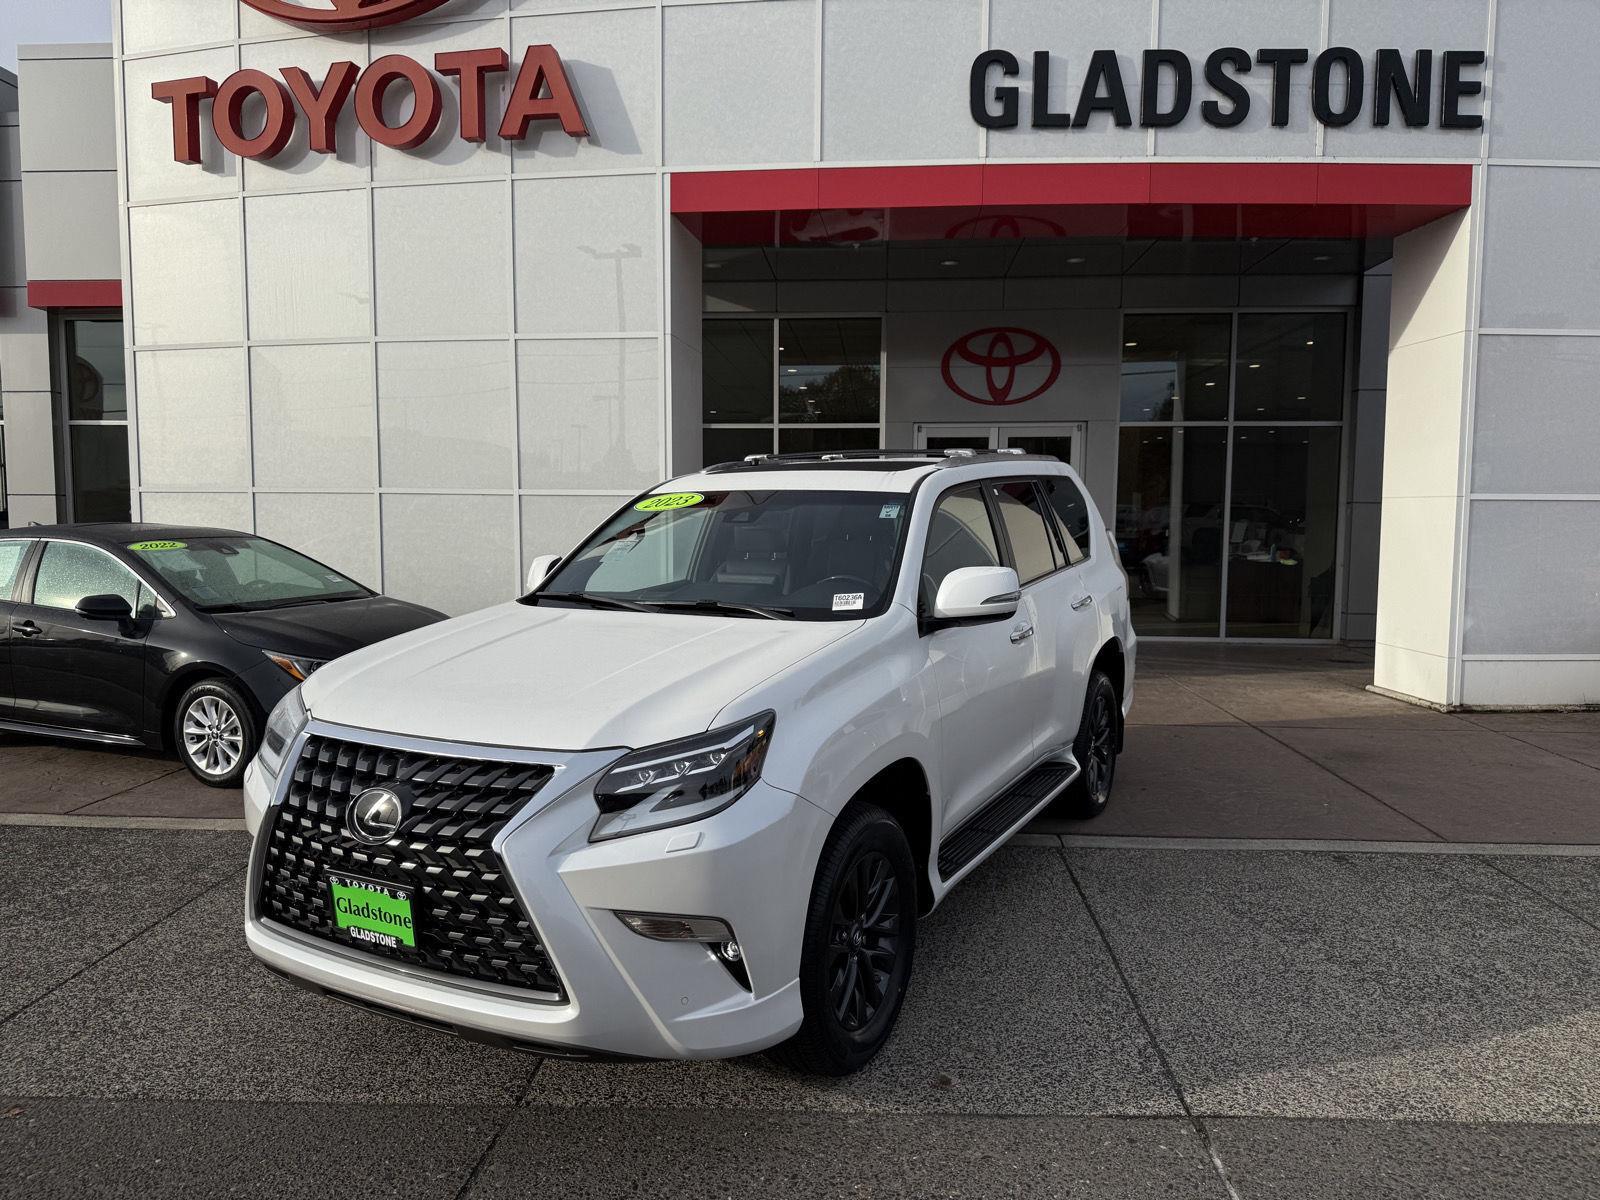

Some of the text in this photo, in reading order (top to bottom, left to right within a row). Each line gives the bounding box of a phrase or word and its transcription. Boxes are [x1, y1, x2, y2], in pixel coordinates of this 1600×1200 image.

[969, 46, 1485, 130] GLADSTONE
[151, 44, 590, 164] TOYOTA
[643, 495, 695, 509] 2023
[140, 542, 178, 550] 2022
[345, 879, 390, 897] TOYOTA
[336, 897, 412, 929] Gladstone
[350, 926, 397, 948] GLADSTONE
